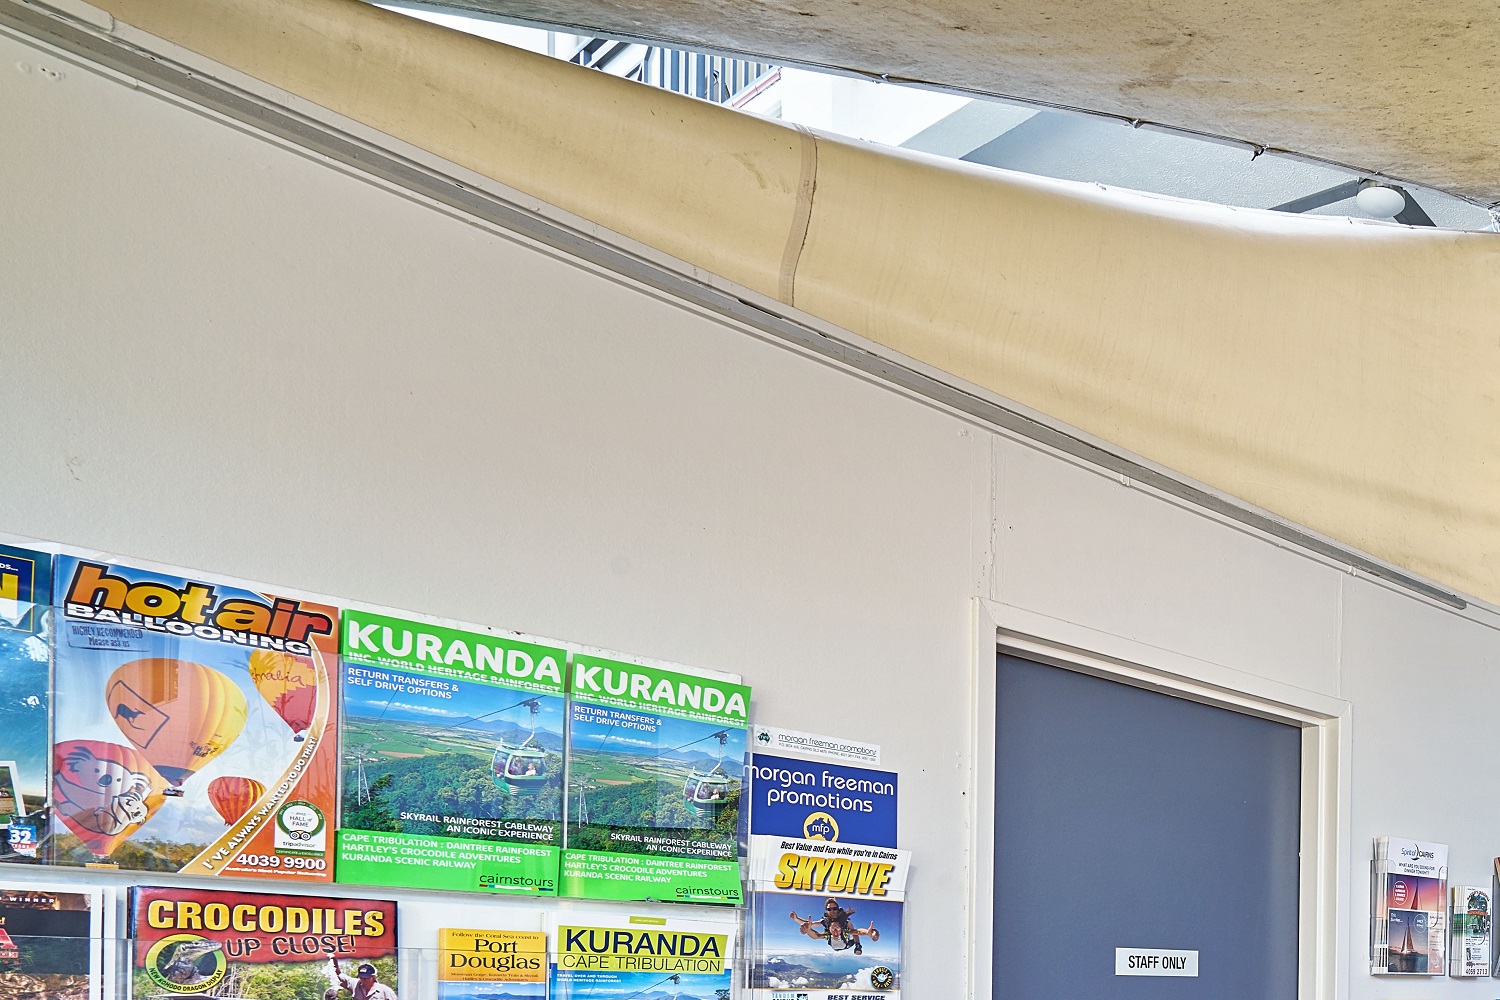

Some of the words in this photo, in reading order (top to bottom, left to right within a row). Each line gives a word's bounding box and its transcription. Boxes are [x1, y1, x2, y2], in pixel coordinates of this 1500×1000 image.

[66, 560, 217, 628] hot
[211, 596, 334, 644] air
[64, 604, 312, 656] BALLOONING
[348, 619, 563, 684] KURANDA
[347, 667, 389, 681] RETURN
[391, 673, 449, 692] TRANSFERS
[451, 683, 459, 693] &
[347, 676, 371, 687] SELF
[373, 679, 403, 693] DRIVE
[405, 685, 453, 699] OPTIONS
[575, 665, 748, 718] KURANDA
[744, 765, 815, 787] morgan
[822, 771, 894, 795] freeman
[767, 789, 873, 812] promotions
[236, 853, 280, 868] 4039
[283, 857, 326, 871] 9900
[774, 853, 893, 895] SKYDIVE
[479, 874, 554, 888] cairnstours
[148, 900, 385, 936] CROCODILES
[226, 937, 261, 956] UP
[272, 935, 356, 955] CLOSE!
[475, 938, 518, 955] Port
[565, 929, 720, 957] KURANDA
[450, 953, 540, 971] Douglas
[562, 955, 611, 969] CAPE
[615, 956, 721, 972] TRIBULATION
[1128, 955, 1159, 968] STAFF
[1162, 956, 1186, 969] ONLY
